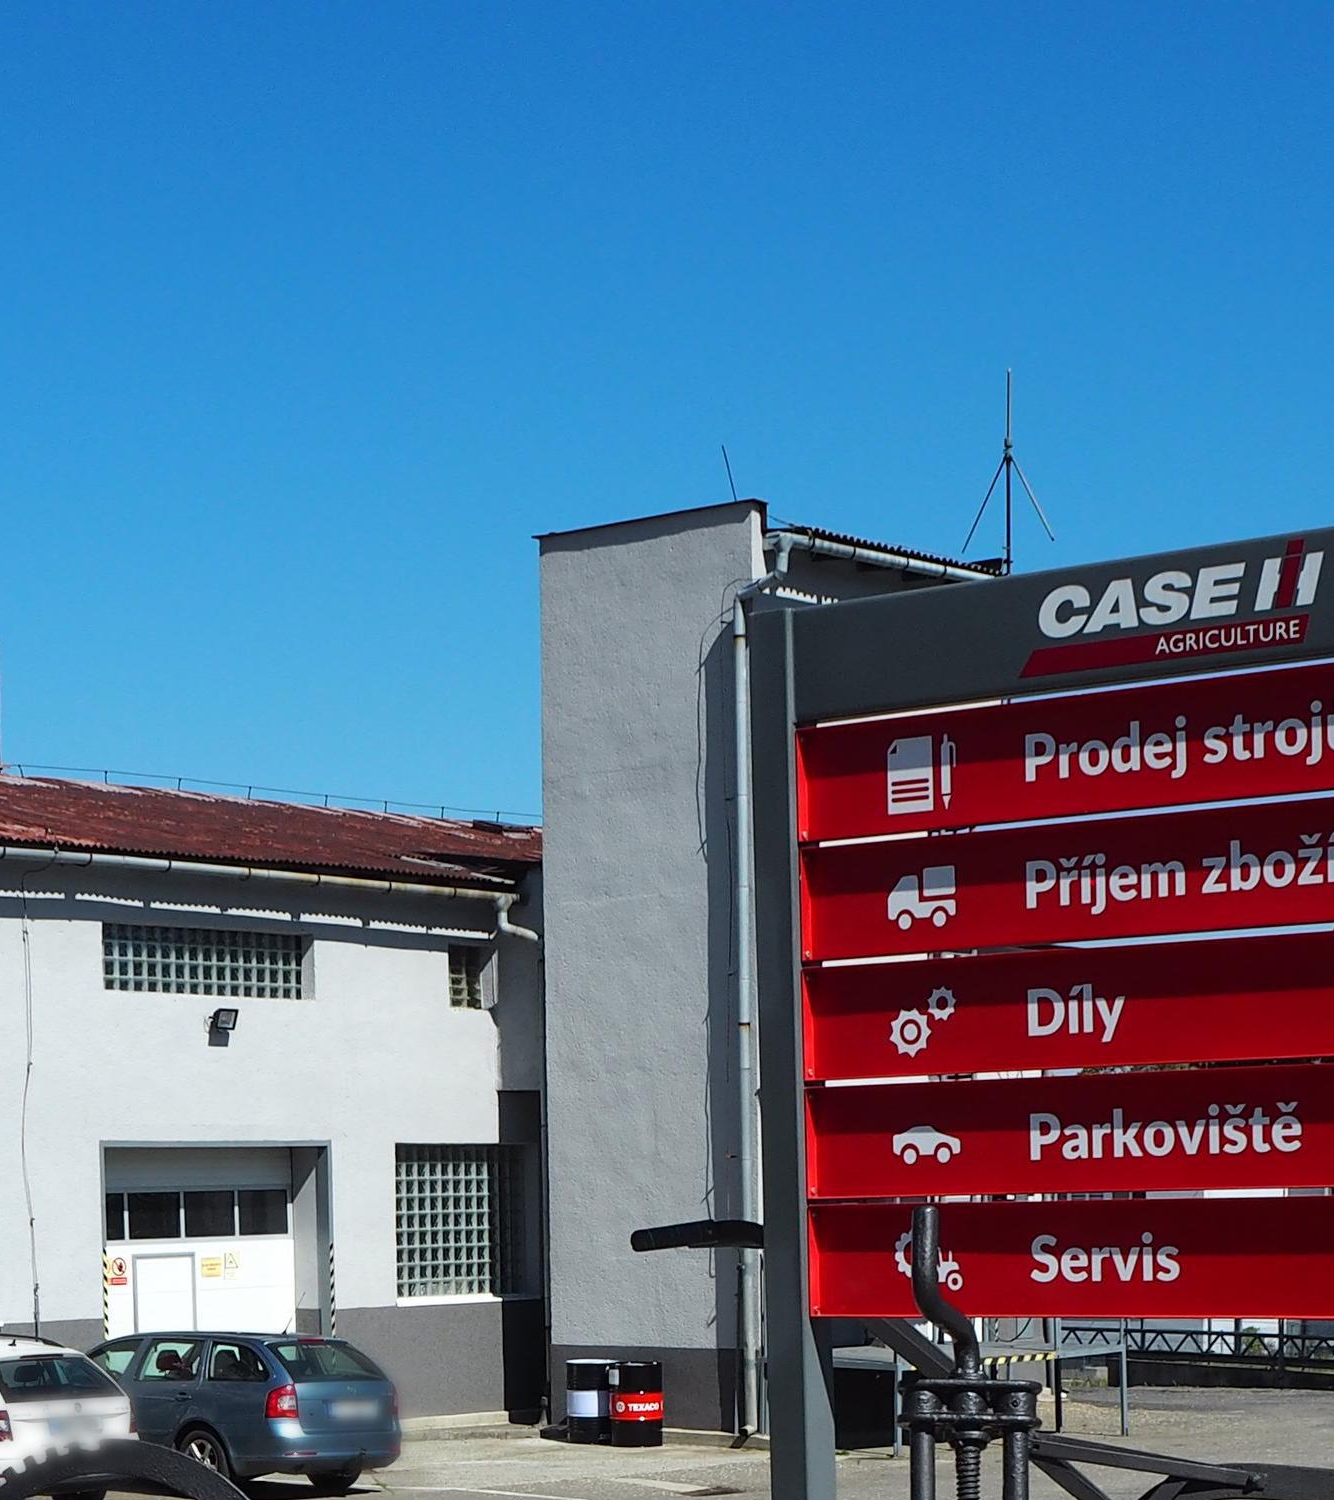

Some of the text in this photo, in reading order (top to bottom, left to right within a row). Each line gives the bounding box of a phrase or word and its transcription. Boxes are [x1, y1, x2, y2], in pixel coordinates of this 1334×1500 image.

[1038, 562, 1246, 638] CASE
[1155, 620, 1300, 655] AGRICULTURE
[1025, 715, 1187, 783] Prodej
[1025, 853, 1186, 915] Příjem
[1027, 983, 1125, 1043] Díly
[1029, 1101, 1303, 1161] Parkoviště
[1030, 1231, 1181, 1283] Servis
[627, 1402, 660, 1412] TEXACO
